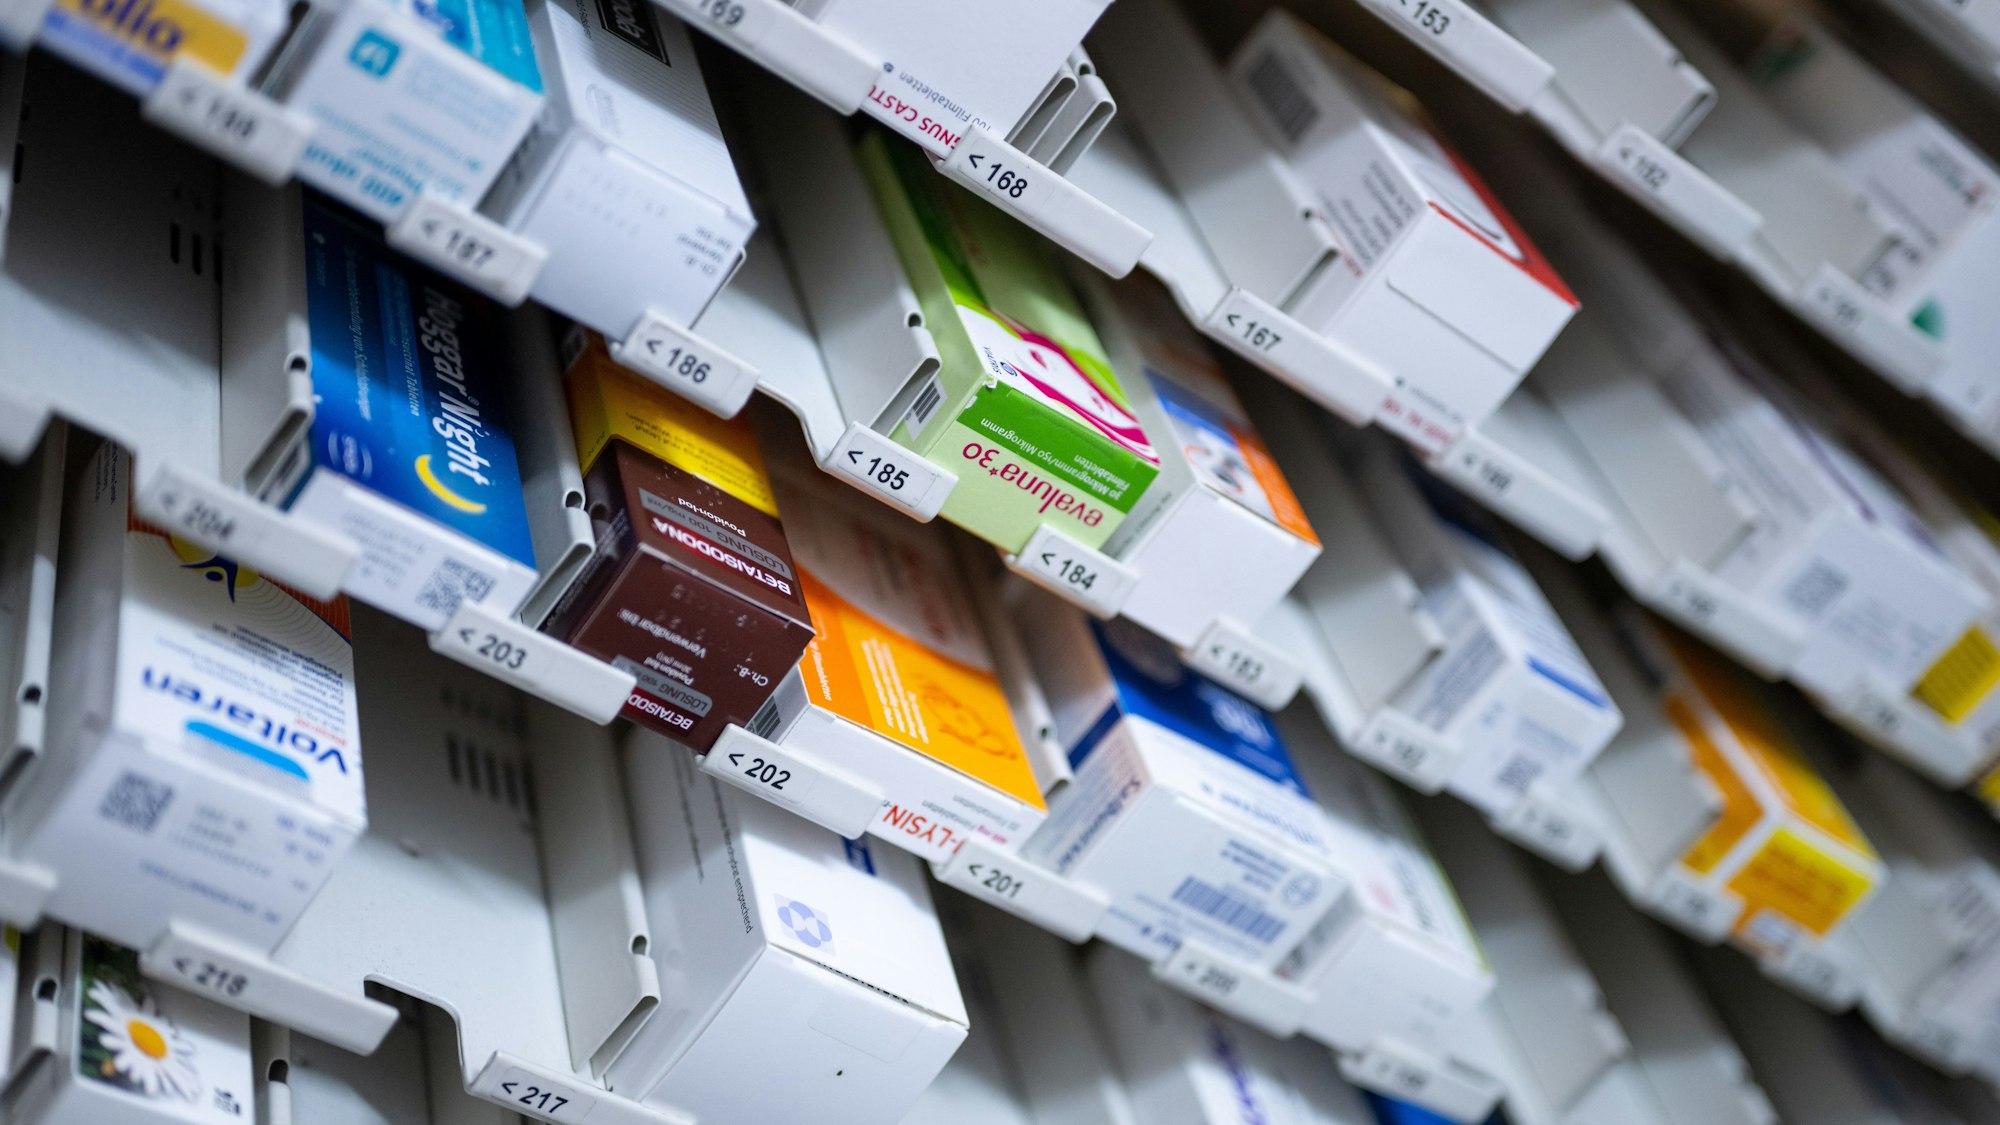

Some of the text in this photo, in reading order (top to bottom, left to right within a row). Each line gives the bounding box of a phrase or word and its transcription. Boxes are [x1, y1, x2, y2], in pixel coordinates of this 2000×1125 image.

[1413, 0, 1450, 36] 153
[899, 72, 972, 122] Filmtabletten
[986, 162, 1029, 199] 168
[1242, 321, 1283, 352] 167
[666, 346, 711, 385] 186
[433, 390, 490, 486] Night
[866, 457, 910, 491] 185
[981, 418, 1123, 501] 30 Mikrogramm/150 Mikrogramm
[1074, 455, 1130, 491] Filmtabletten
[688, 517, 711, 533] 100
[653, 518, 791, 595] BETAISODONA
[1056, 558, 1098, 592] 184
[480, 634, 527, 670] 203
[658, 683, 708, 711] LÖSUNG
[143, 668, 347, 774] Voltaren
[745, 757, 791, 791] 202
[983, 869, 1025, 898] 201
[734, 877, 754, 934] entsprechend
[518, 1086, 569, 1114] 217
